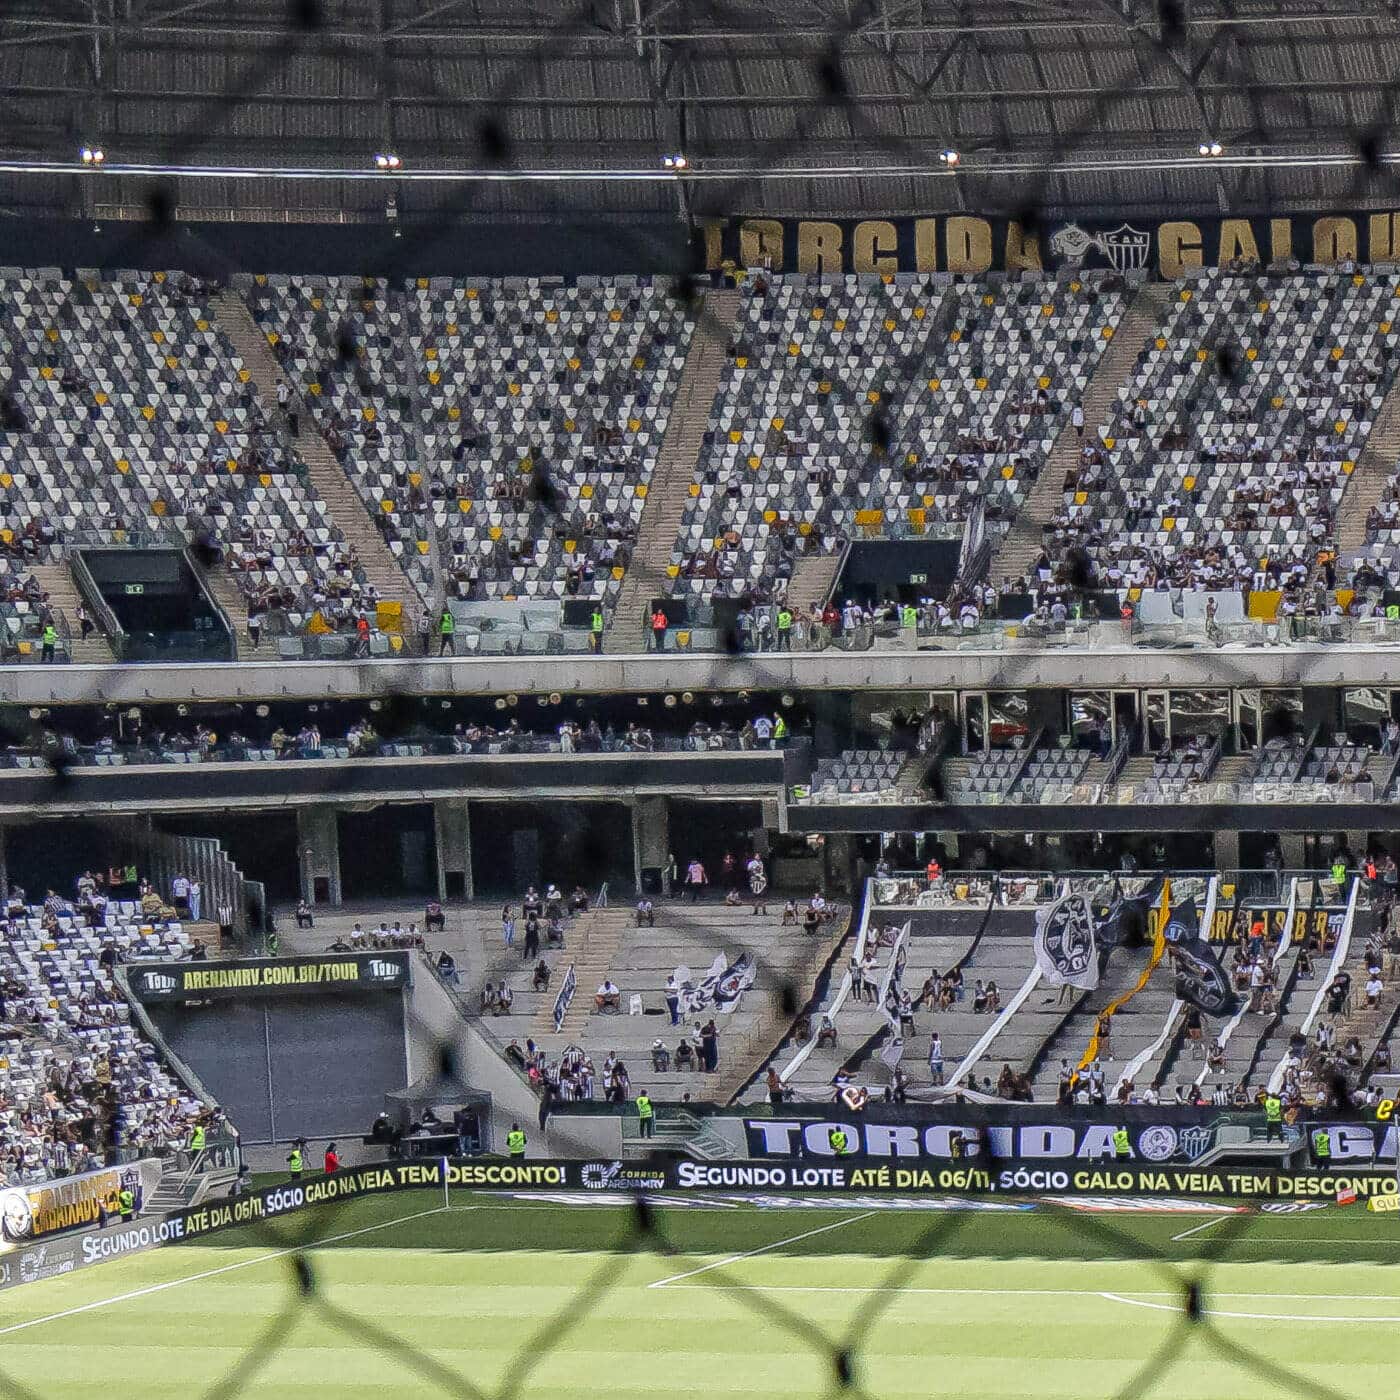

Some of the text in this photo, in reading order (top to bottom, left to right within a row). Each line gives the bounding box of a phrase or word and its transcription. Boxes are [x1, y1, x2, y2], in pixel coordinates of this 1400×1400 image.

[183, 962, 359, 990] ARENAMRV.COM.BR/TOUR
[678, 1161, 786, 1188] SEGUNDO
[792, 1168, 845, 1186] LOTE
[850, 1165, 890, 1188] ATÉ
[896, 1169, 935, 1188] DIA
[938, 1169, 996, 1192] 06/11,
[1000, 1167, 1068, 1189] SÓCIO
[1073, 1171, 1133, 1191] GALO
[1140, 1173, 1167, 1191] NA
[1173, 1173, 1224, 1193] VEIA
[1227, 1174, 1271, 1194] TEM
[82, 1228, 149, 1263] SEGUNDO
[152, 1218, 184, 1244] LOTE
[186, 1206, 209, 1233] ATÉ
[211, 1205, 233, 1228] DIA
[266, 1187, 304, 1213] SÓCIO
[305, 1180, 337, 1203] GALO
[339, 1177, 357, 1195] NA
[357, 1169, 394, 1191] VEIA
[397, 1166, 440, 1184] TEM
[446, 1166, 567, 1184] DESCONTO!
